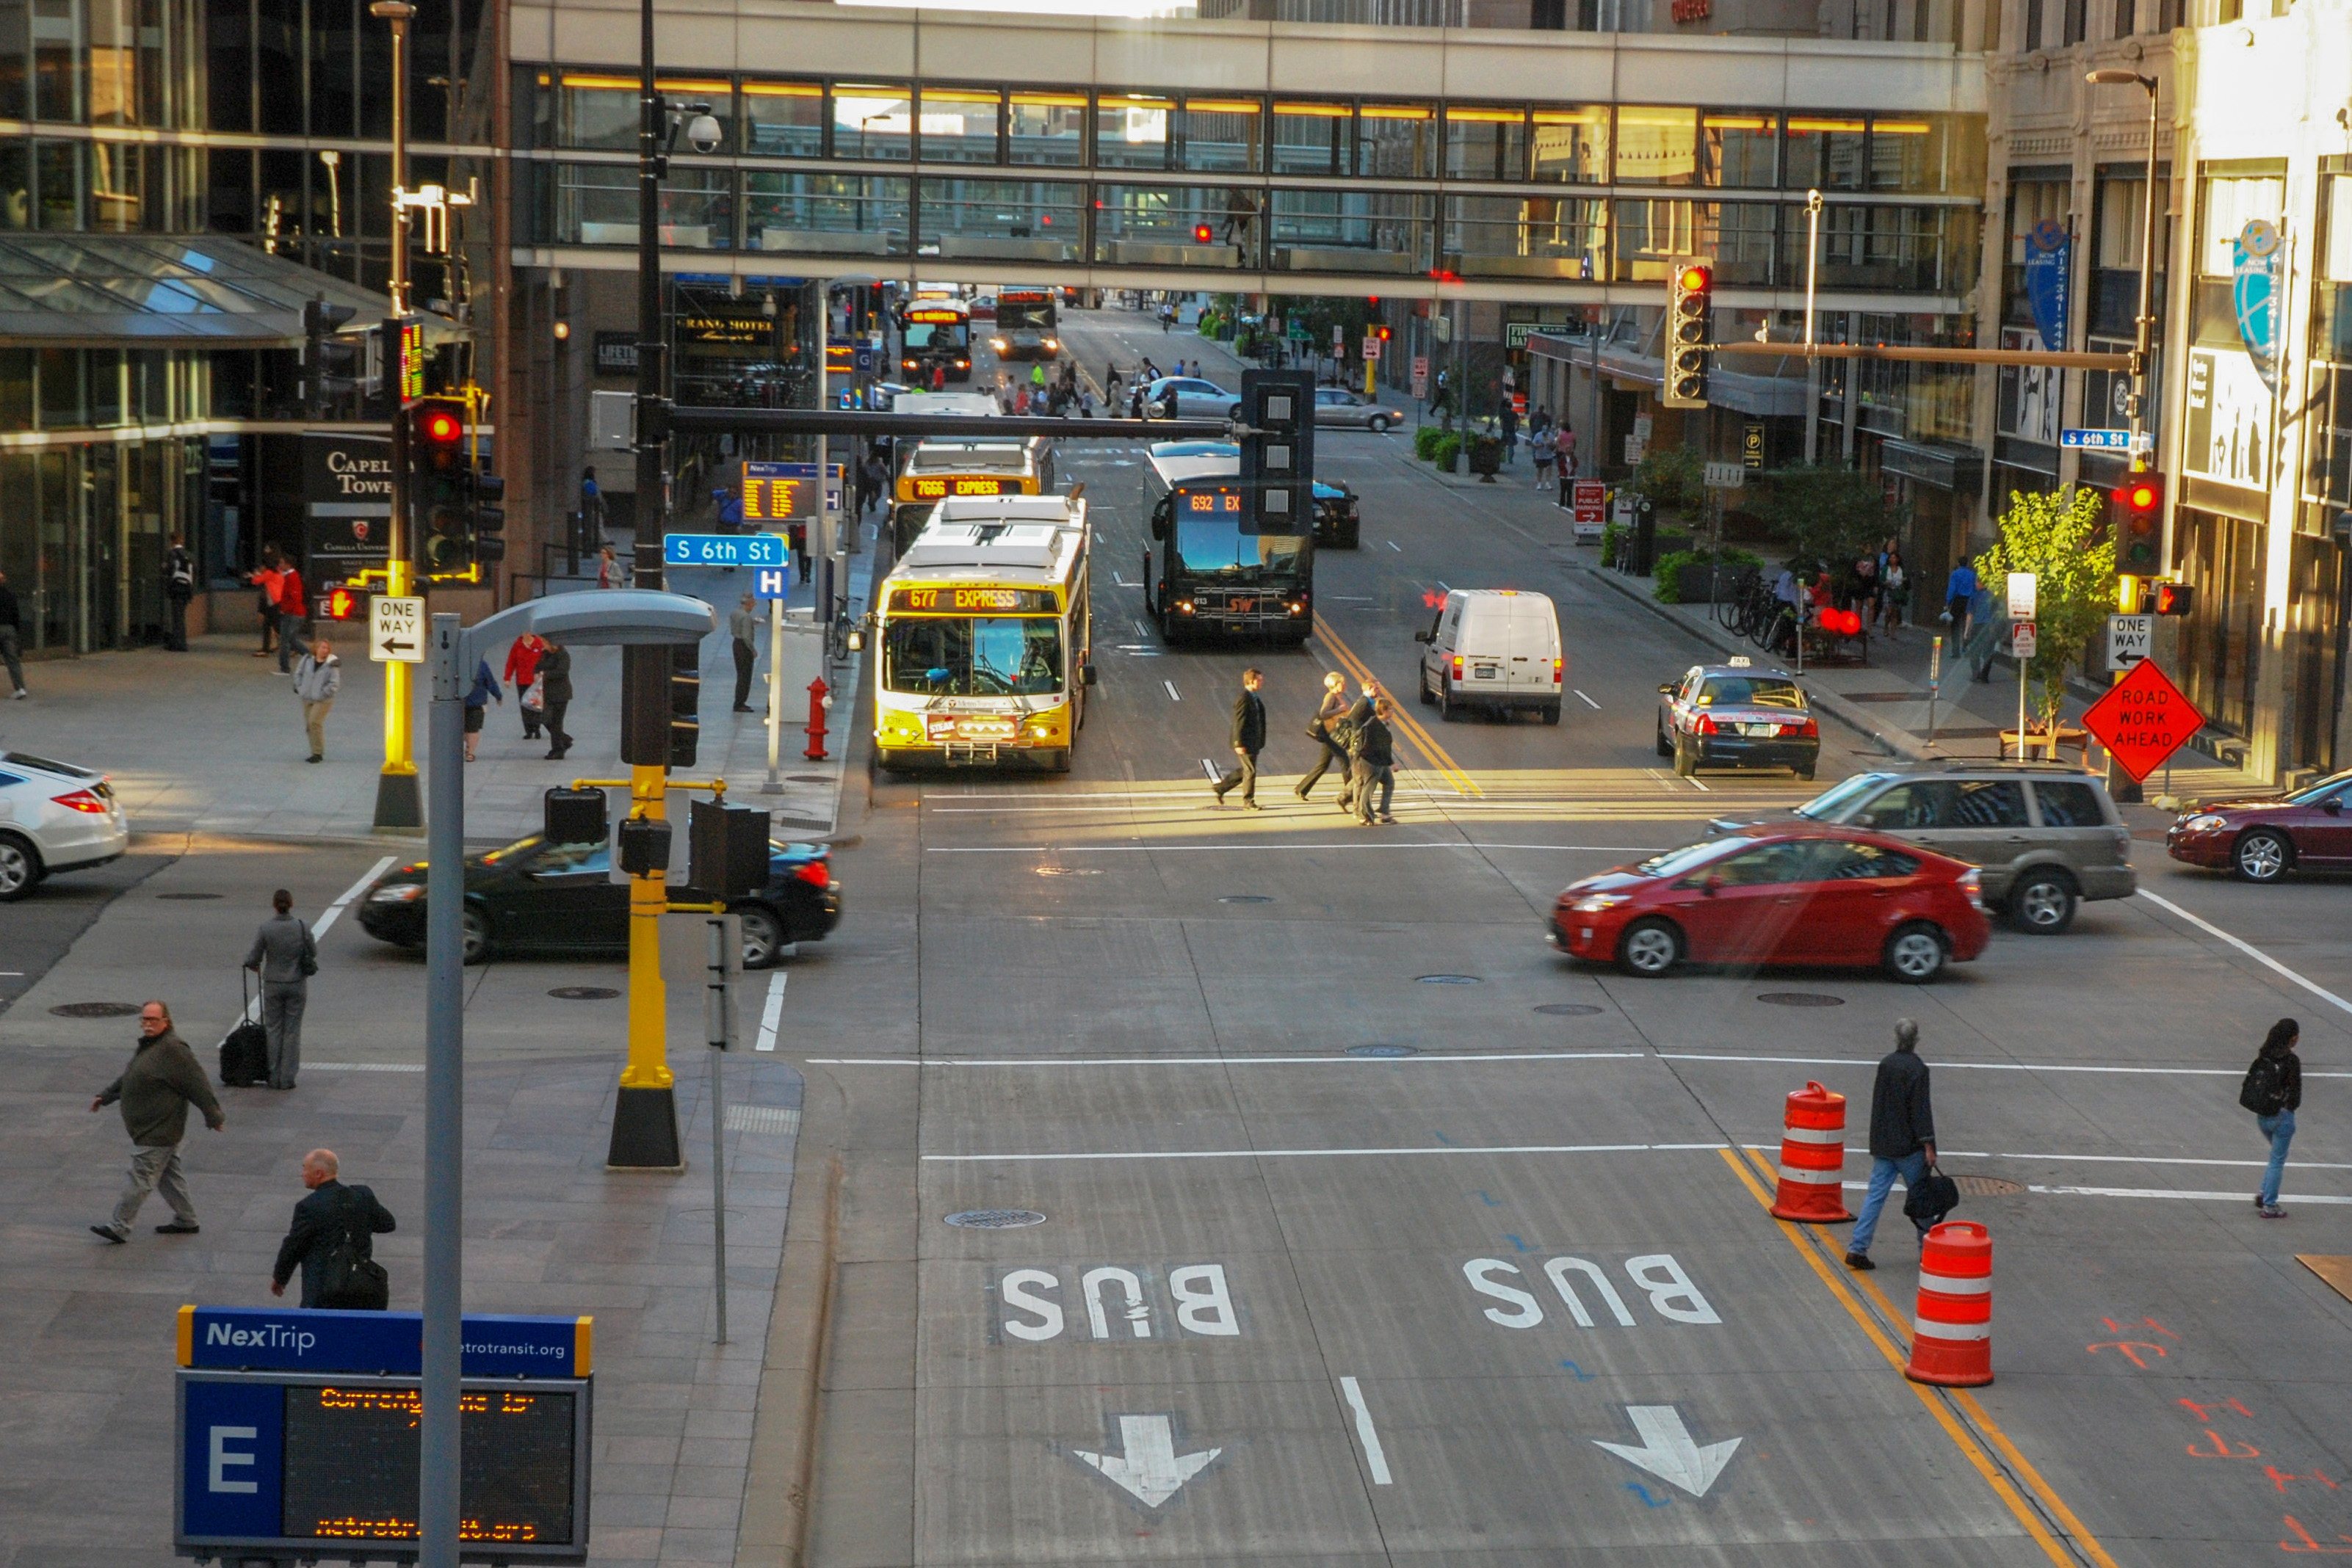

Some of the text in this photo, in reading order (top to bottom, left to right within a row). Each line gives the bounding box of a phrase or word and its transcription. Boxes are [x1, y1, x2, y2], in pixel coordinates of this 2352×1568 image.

[2055, 247, 2066, 352] 612-341-444
[859, 355, 870, 366] G
[2069, 432, 2124, 446] S 6th St
[337, 475, 394, 494] TOWE
[956, 481, 999, 495] EXPRESS
[1192, 496, 1214, 511] 692
[677, 540, 771, 561] S 6th St
[760, 570, 782, 594] H
[911, 589, 1016, 608] 677 EXPRESS
[381, 603, 414, 617] ONE
[380, 620, 414, 634] WAY
[2117, 620, 2146, 631] ONE
[2116, 634, 2146, 647] WAY
[2122, 690, 2168, 705] ROAD
[2119, 711, 2166, 725] WORK
[2114, 732, 2174, 747] AHEAD
[1463, 1254, 1723, 1329] BUS
[1002, 1264, 1240, 1341] BUS
[206, 1323, 316, 1356] NexTrip
[460, 1343, 564, 1359] etrotransit.org
[208, 1426, 258, 1493] E
